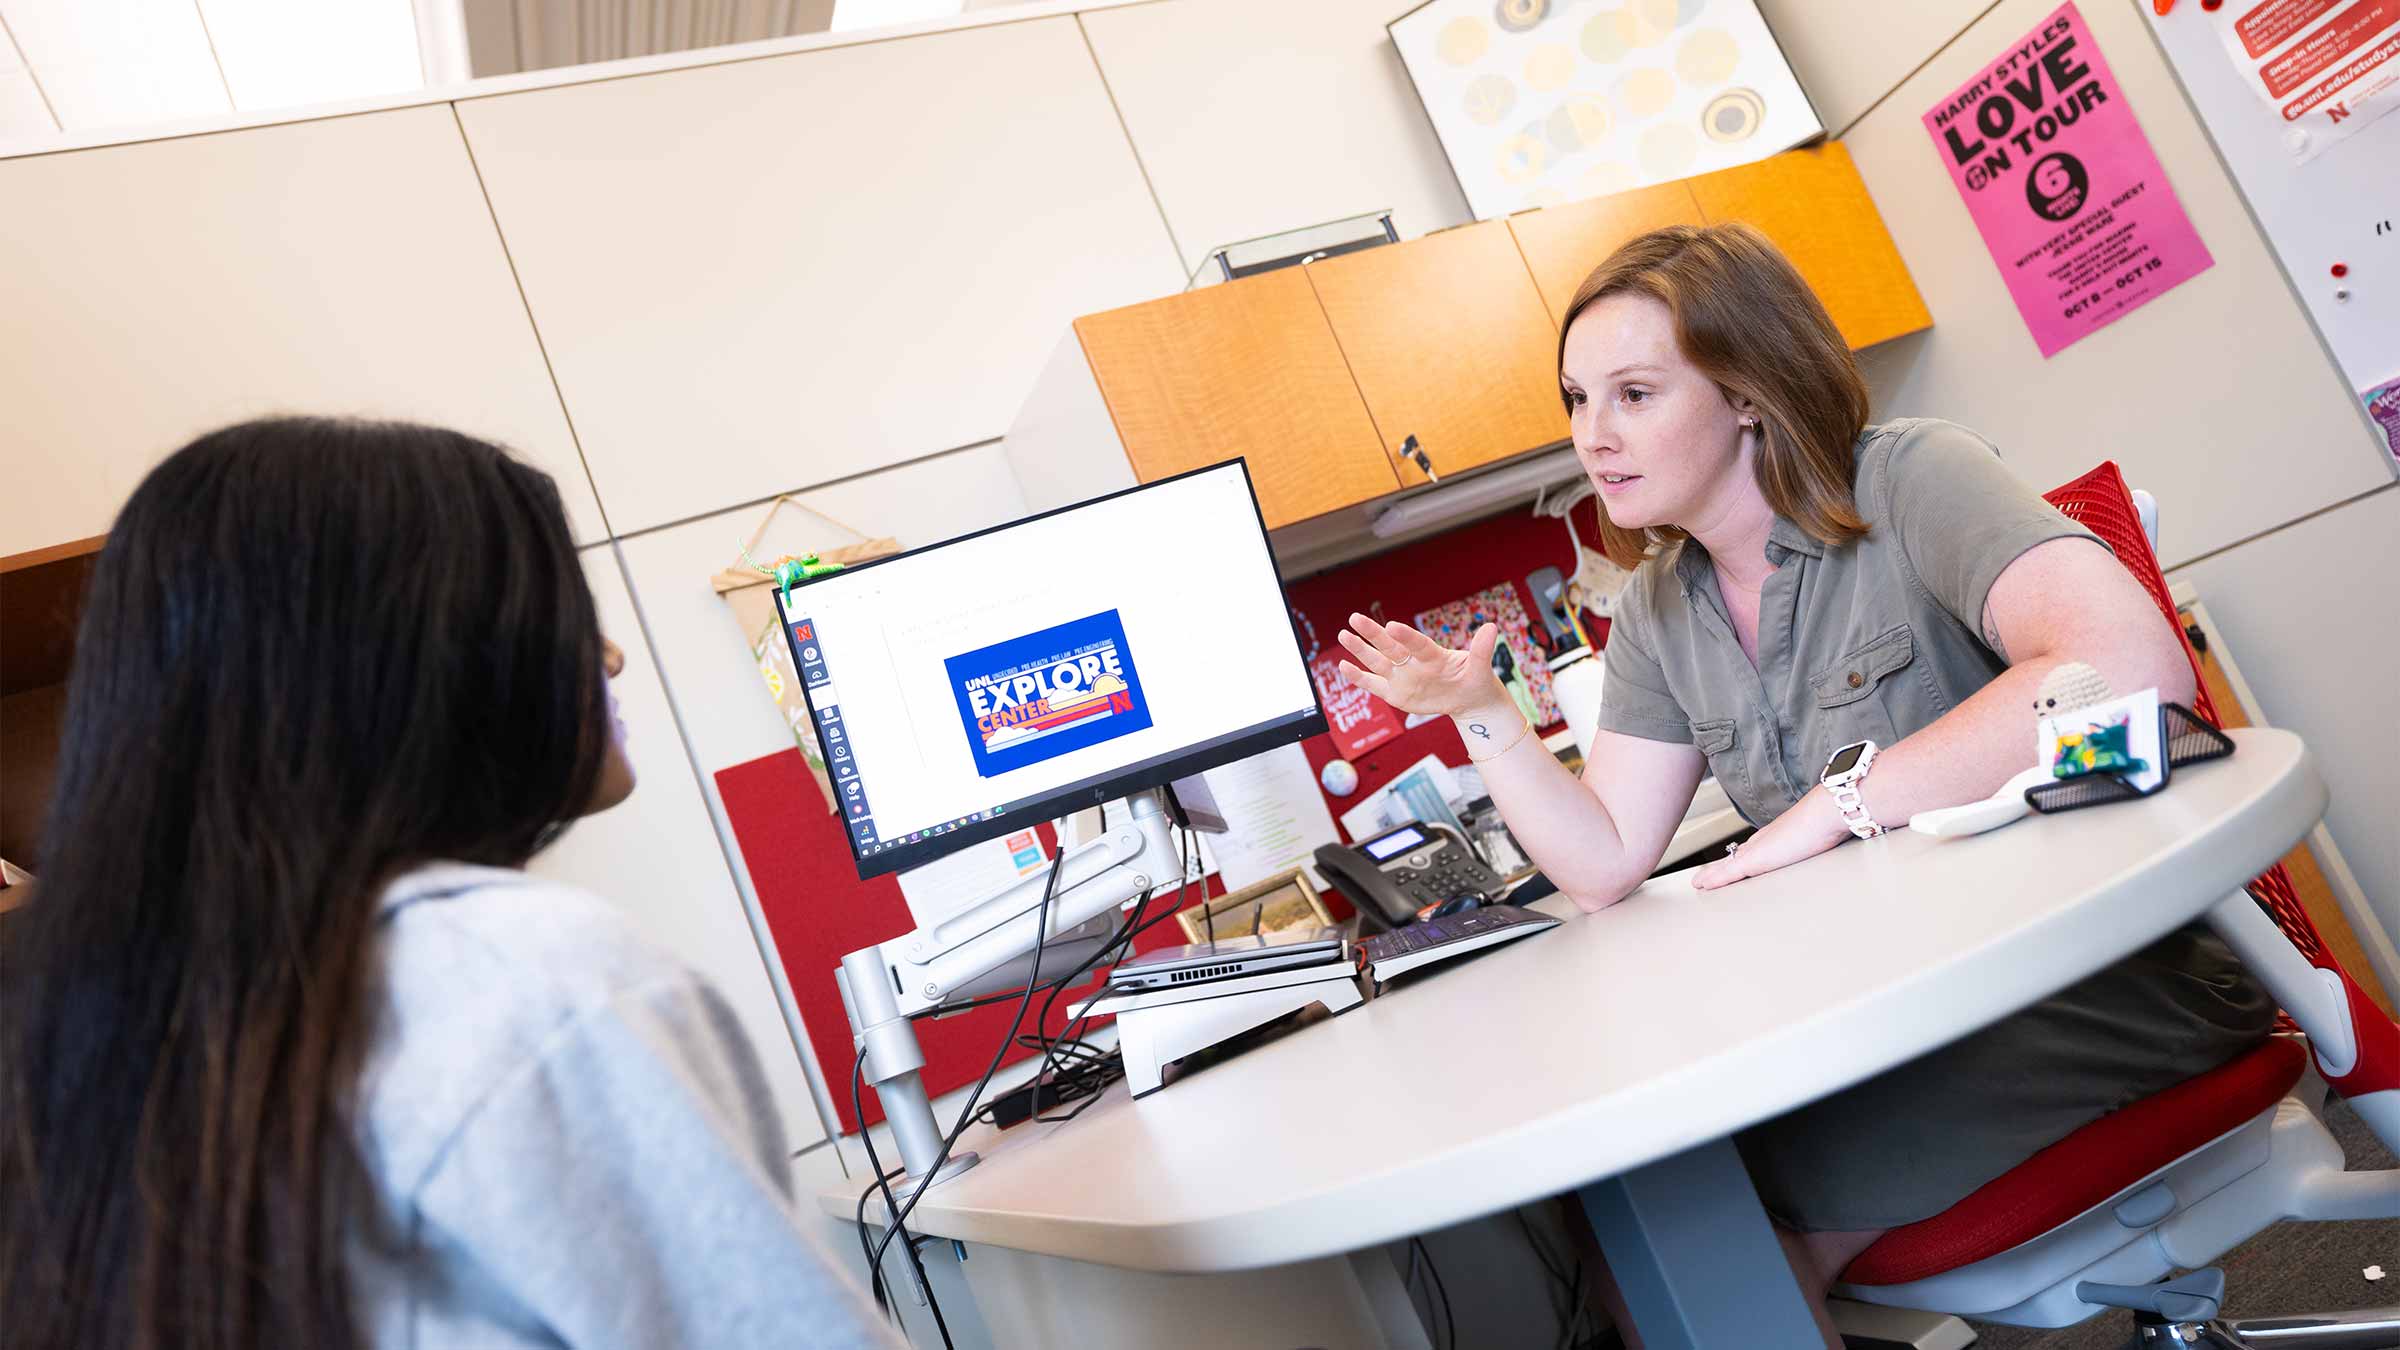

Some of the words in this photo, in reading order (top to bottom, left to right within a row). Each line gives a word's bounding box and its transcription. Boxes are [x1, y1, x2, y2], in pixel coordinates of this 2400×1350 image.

[1935, 75, 1992, 127] HARRY
[1996, 17, 2070, 81] STYLES
[2269, 48, 2306, 77] Drop-in
[2306, 29, 2336, 51] Hours
[1943, 36, 2090, 166] LOVE
[2011, 80, 2108, 156] TOUR
[2326, 101, 2350, 124] N
[2043, 234, 2066, 251] VERY
[2068, 207, 2109, 234] SPECIAL
[2111, 182, 2145, 208] GUEST
[2064, 299, 2089, 319] OCT
[2116, 267, 2143, 289] OCT
[2145, 257, 2162, 272] 15
[795, 624, 813, 643] N
[965, 675, 993, 692] UNL
[968, 648, 1123, 719] EXPLORE
[1031, 657, 1049, 668] HEALTH
[1060, 651, 1071, 660] LAW
[978, 698, 1050, 732] CENTER
[1110, 690, 1135, 715] N
